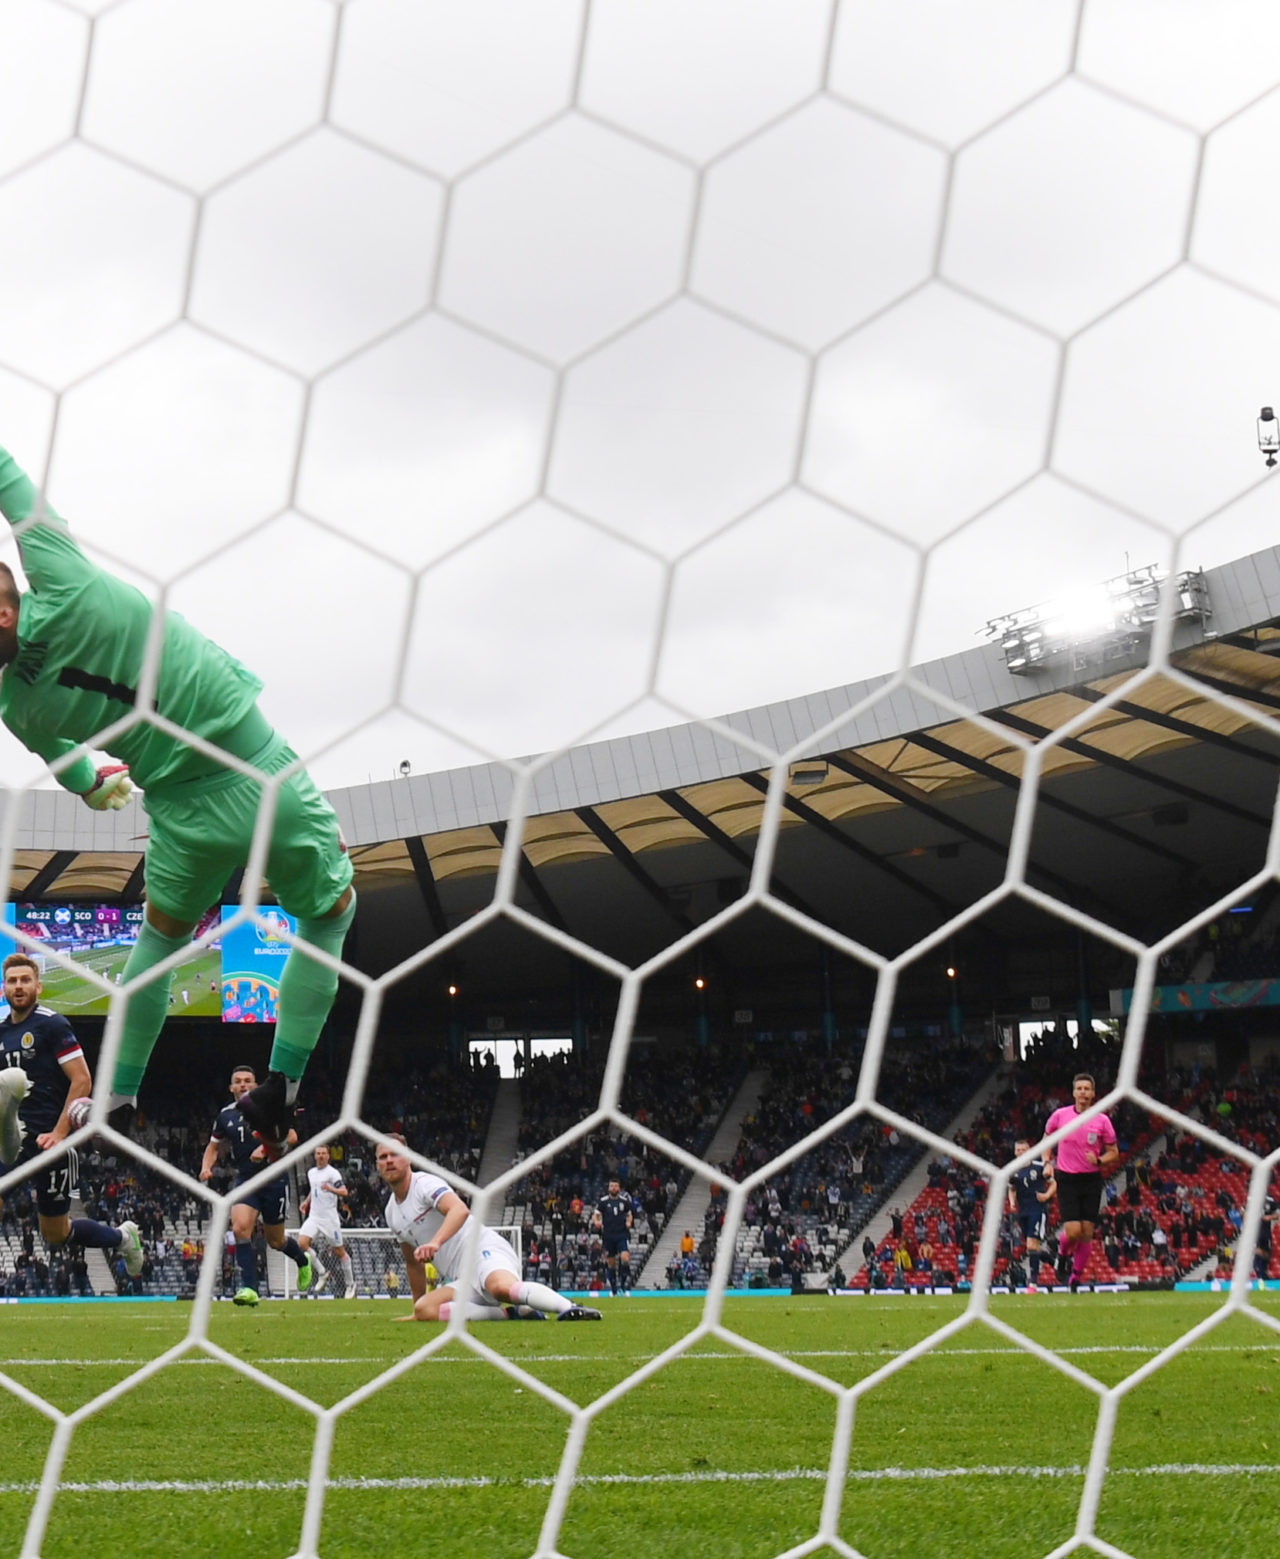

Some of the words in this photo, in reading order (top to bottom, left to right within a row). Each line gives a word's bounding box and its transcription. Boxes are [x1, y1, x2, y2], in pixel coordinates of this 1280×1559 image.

[26, 911, 51, 920] 48:22
[74, 912, 92, 920] SCO
[126, 912, 143, 921] CZE
[47, 1168, 68, 1194] 17
